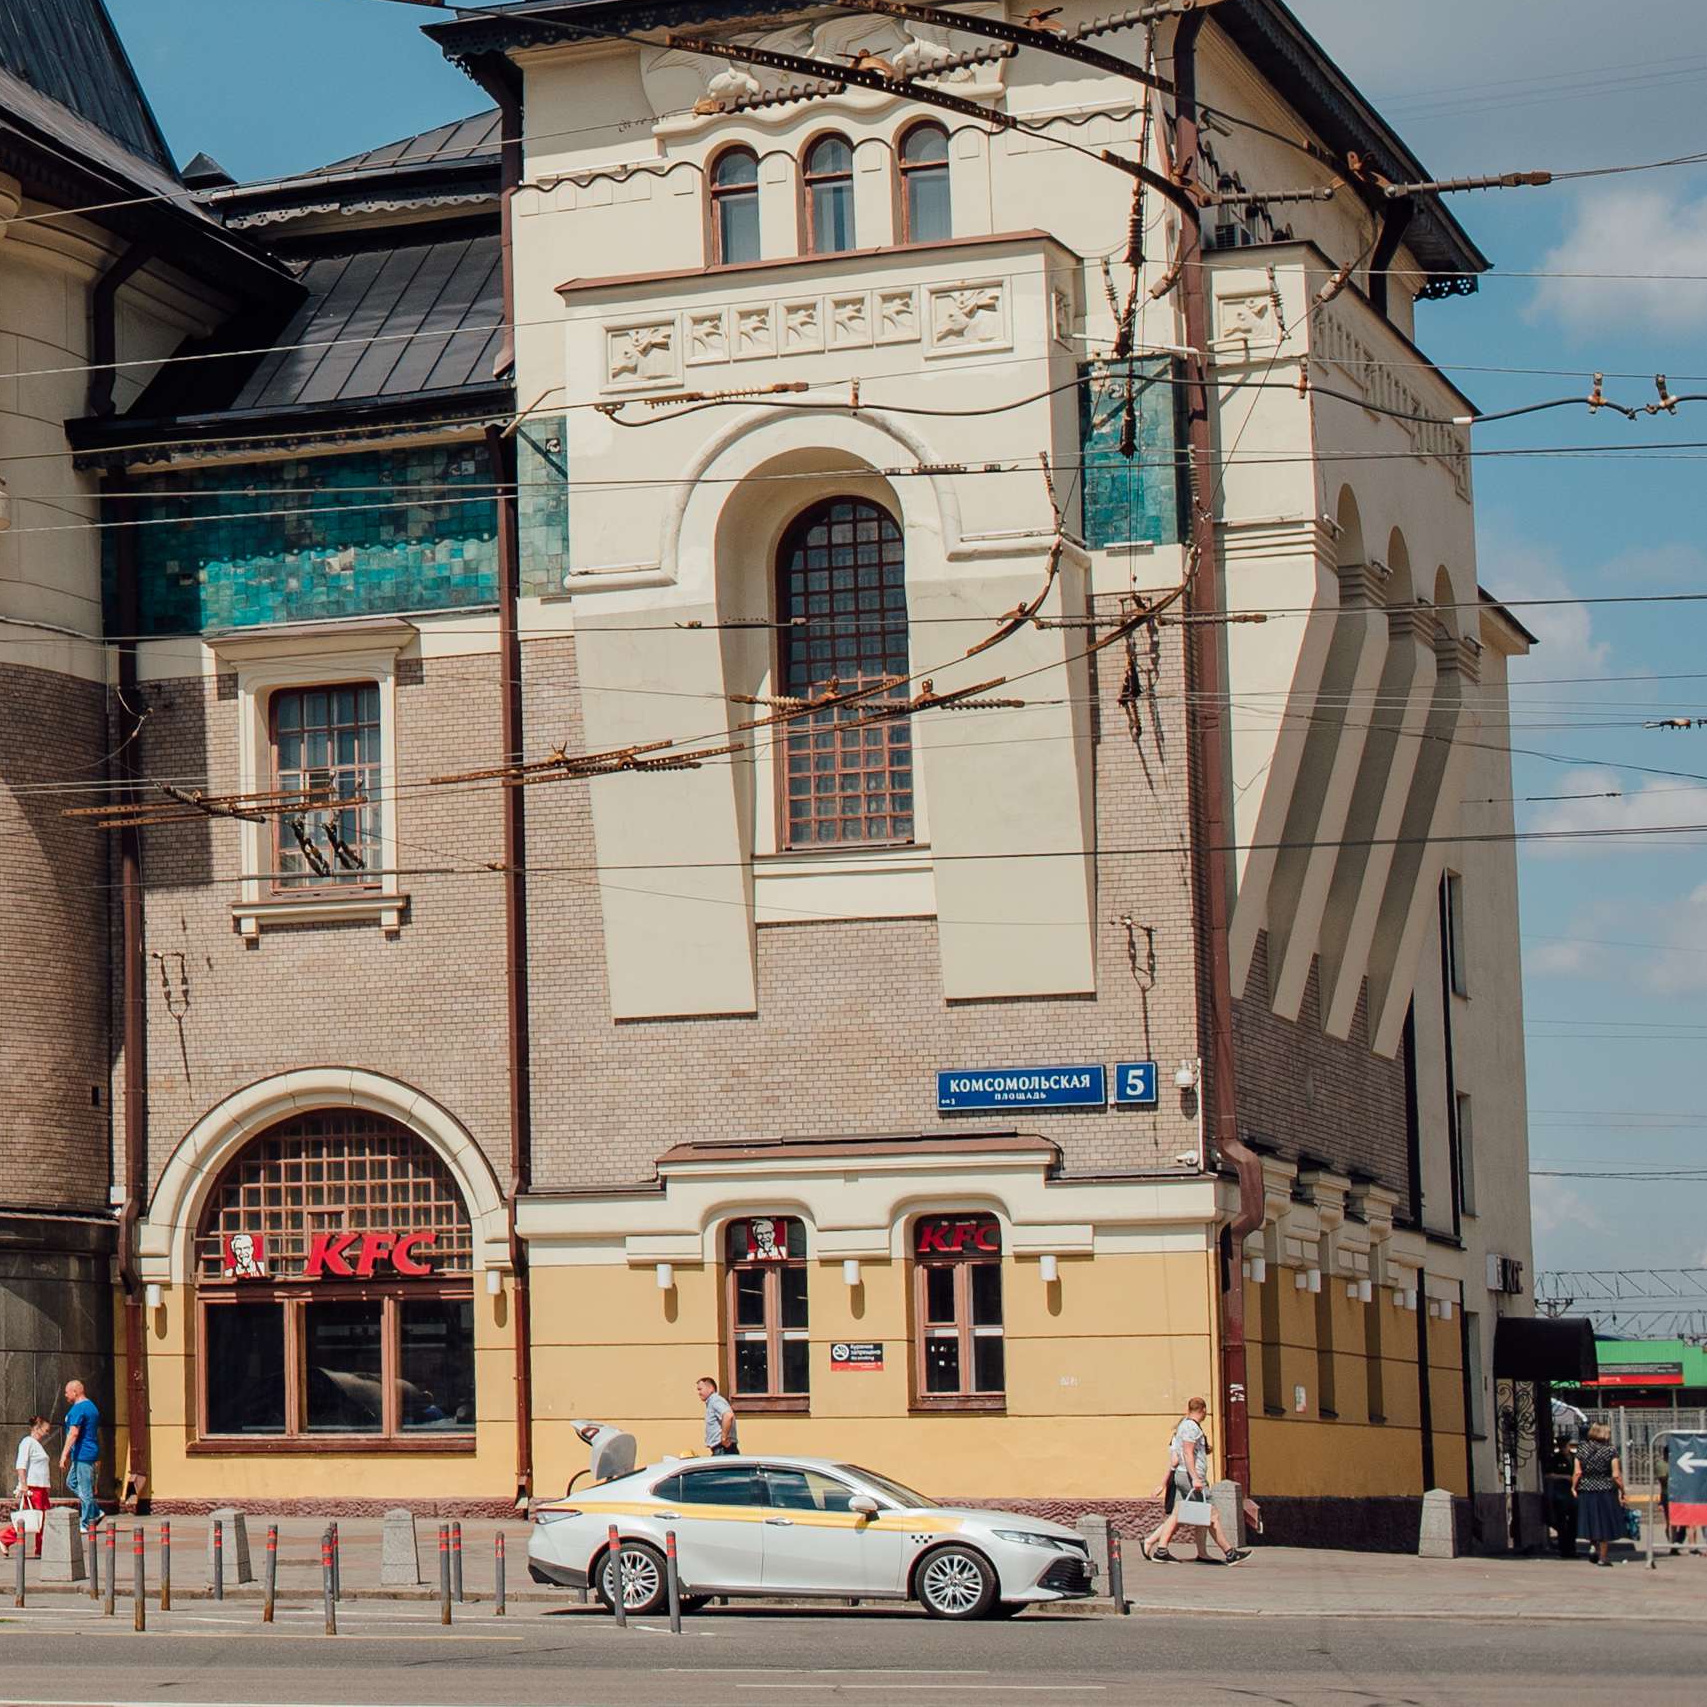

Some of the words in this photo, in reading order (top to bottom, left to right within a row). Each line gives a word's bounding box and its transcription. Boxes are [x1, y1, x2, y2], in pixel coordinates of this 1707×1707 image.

[950, 1073, 1091, 1093] КОМСОМОЛЬСКАЯ
[1126, 1069, 1145, 1095] 5
[994, 1092, 1047, 1101] ПЛОЩАДЬ
[918, 1221, 1000, 1252] KFC
[302, 1231, 439, 1276] KFC
